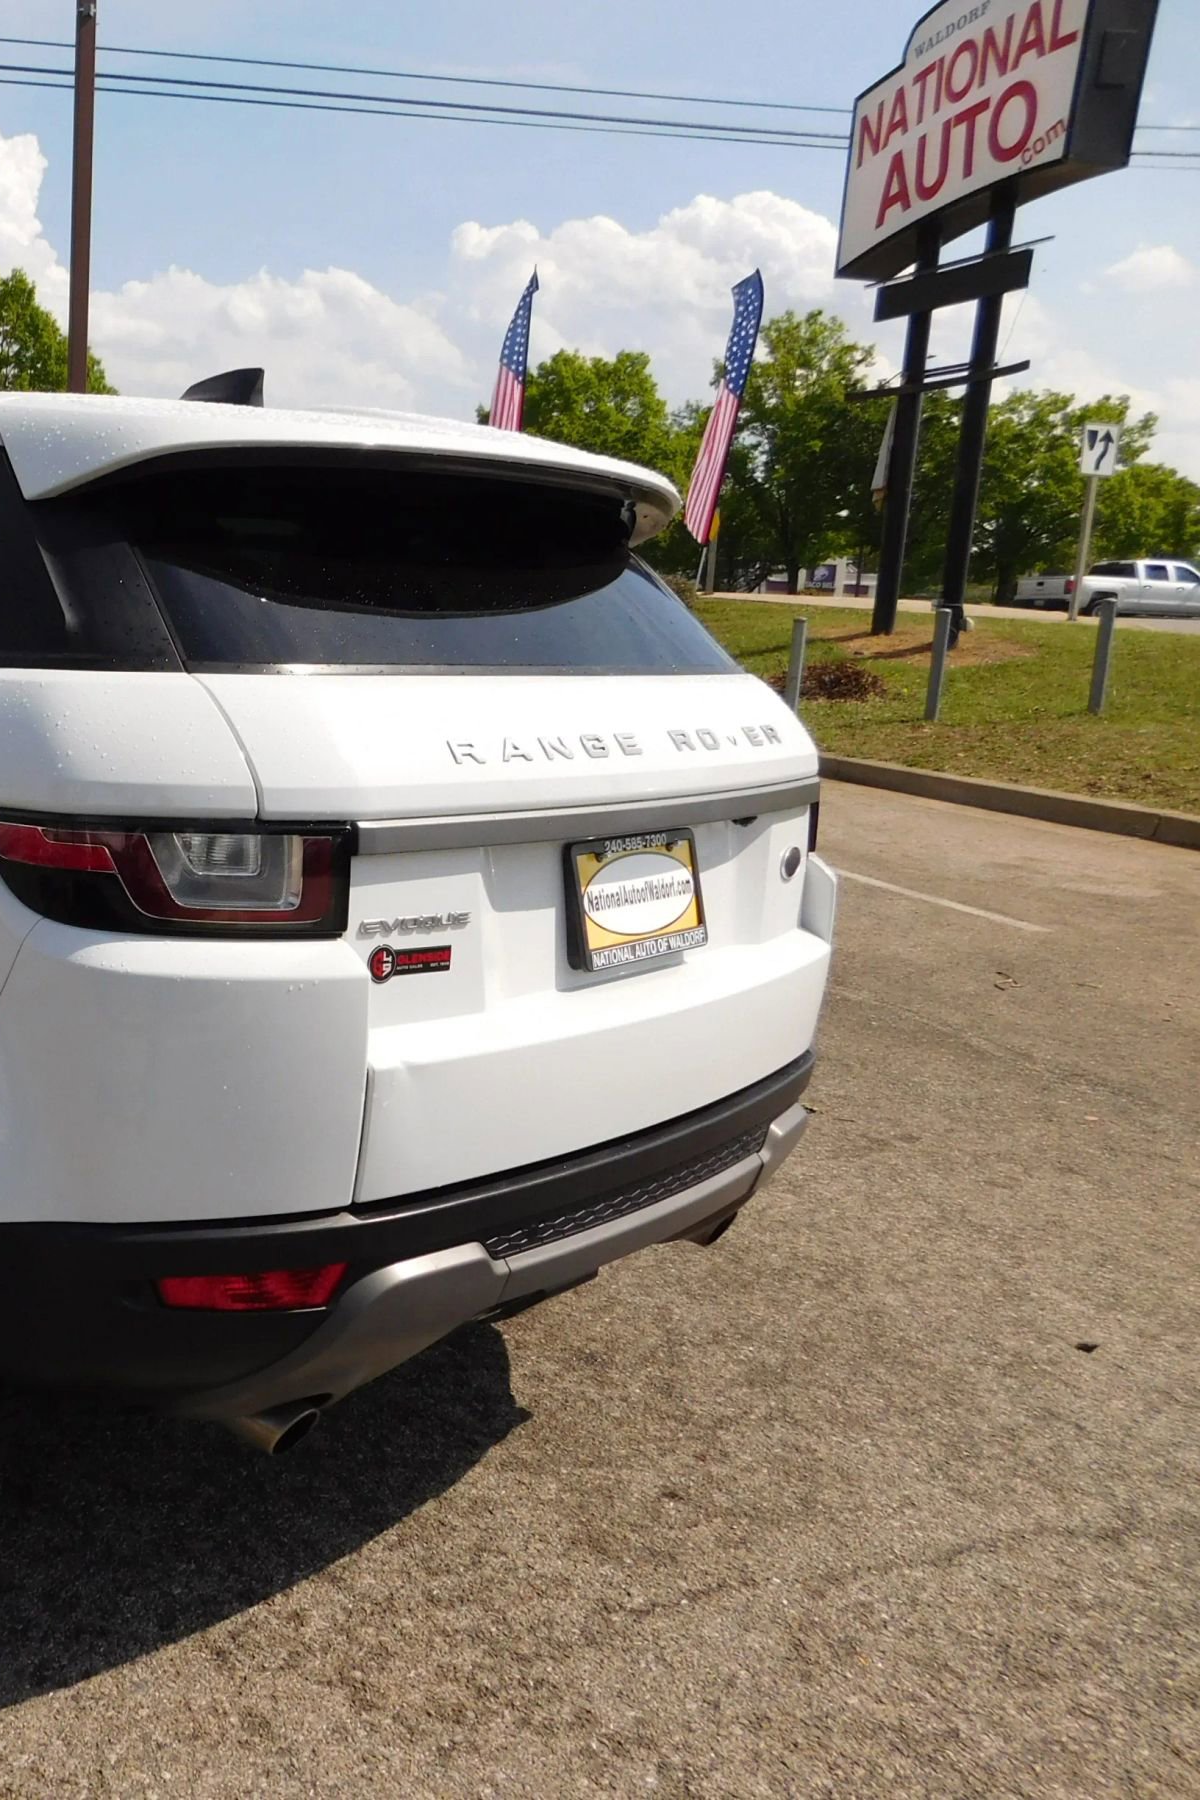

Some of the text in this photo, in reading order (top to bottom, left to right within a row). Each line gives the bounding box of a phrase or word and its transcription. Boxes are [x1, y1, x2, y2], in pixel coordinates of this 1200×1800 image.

[913, 0, 992, 58] WALDORF
[856, 0, 1079, 169] NATIONAL
[875, 79, 1038, 230] AUTO
[446, 724, 782, 765] RANGE ROVER
[586, 875, 692, 914] NationalAutoofWaldorf.com
[358, 911, 472, 935] EVOQUE
[593, 930, 705, 968] NATIONAL AUTO OF WALDORF
